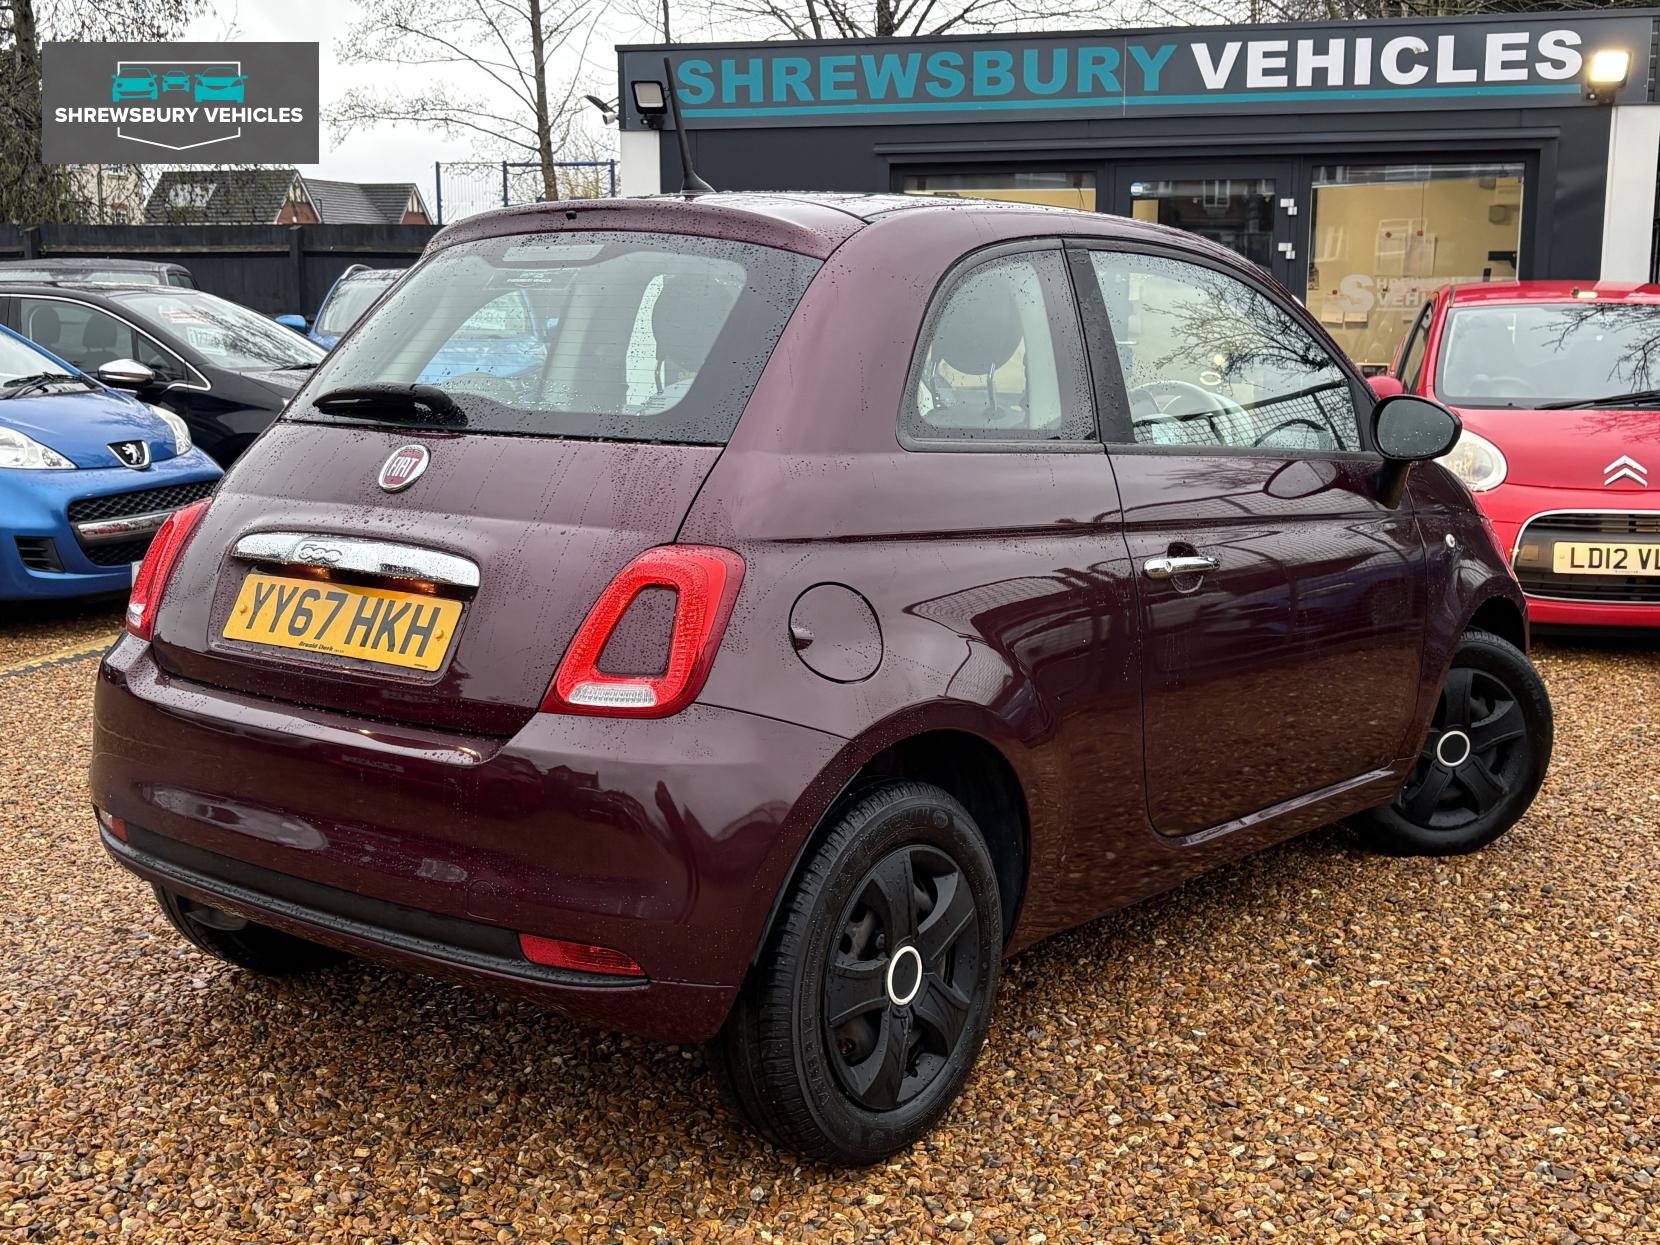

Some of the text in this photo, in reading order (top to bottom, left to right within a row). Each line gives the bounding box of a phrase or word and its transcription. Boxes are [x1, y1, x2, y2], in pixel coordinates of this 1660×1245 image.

[676, 30, 1583, 105] SHREWSBURY VEHICLES
[387, 456, 419, 477] FIAT
[299, 544, 342, 563] 500
[1570, 547, 1628, 569] LD12
[246, 582, 441, 658] YY67 HKH
